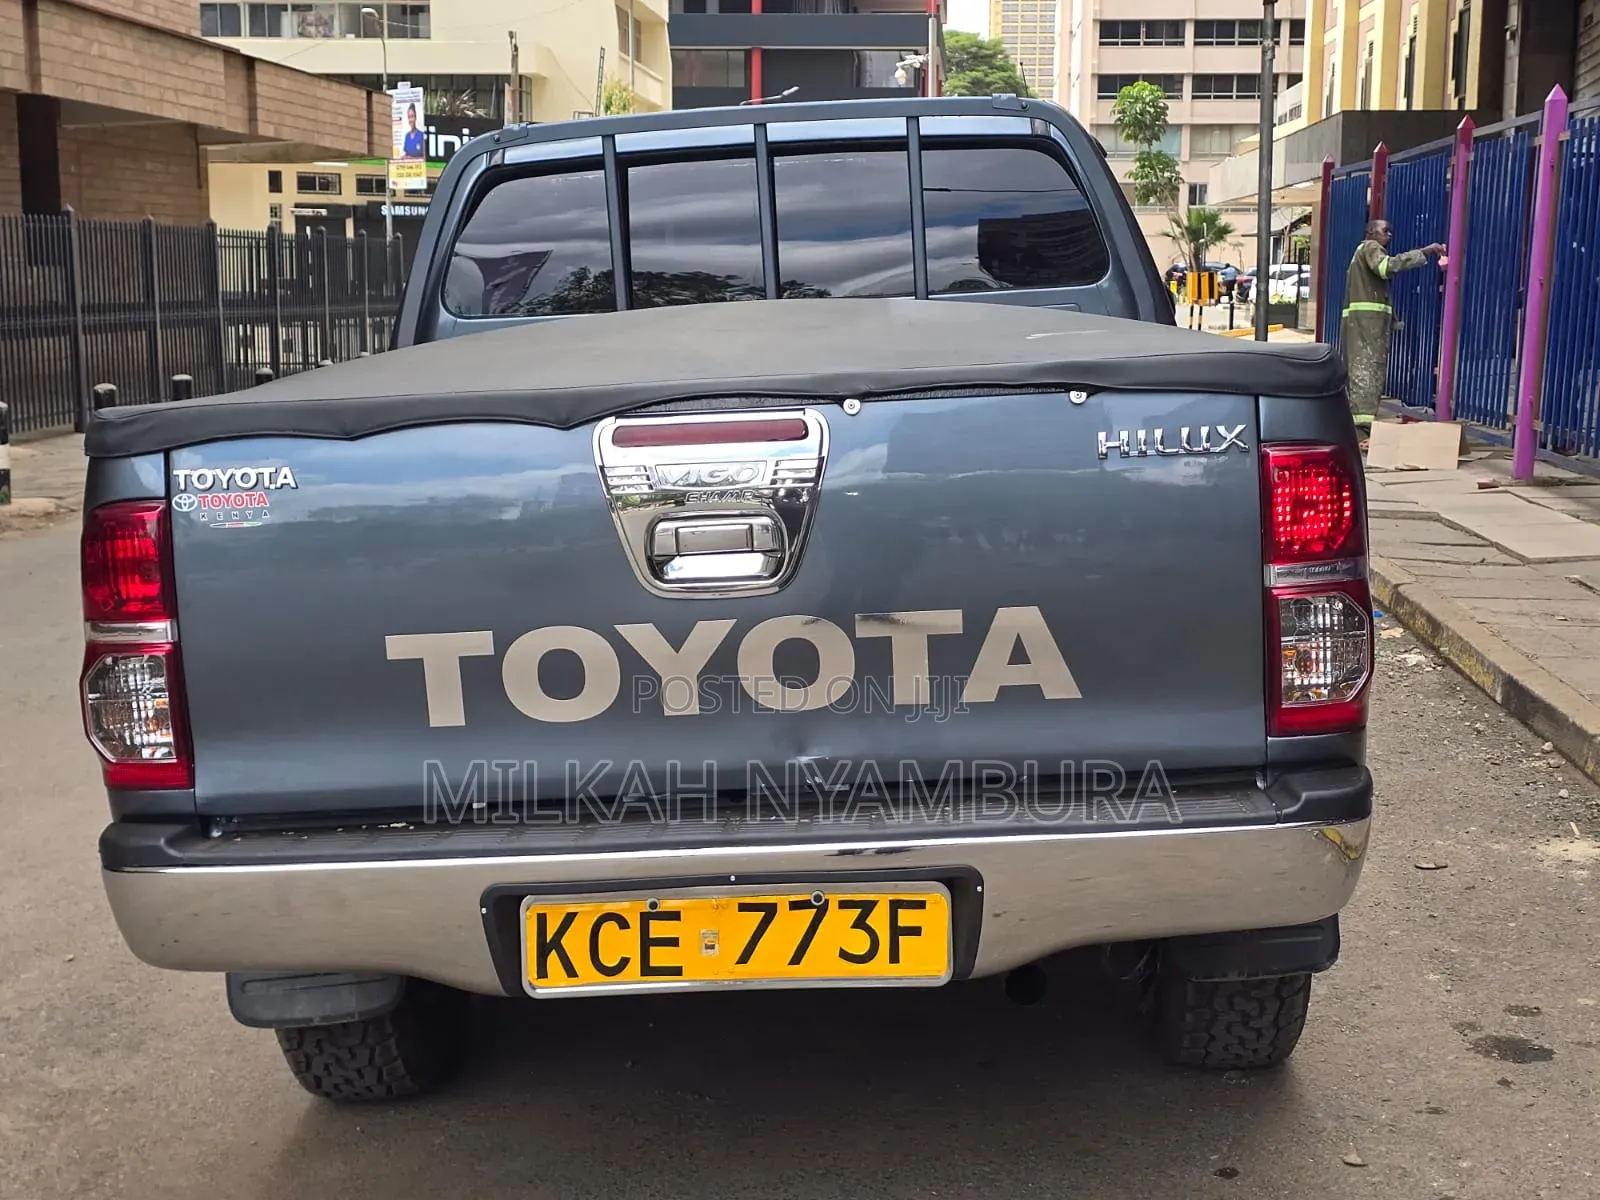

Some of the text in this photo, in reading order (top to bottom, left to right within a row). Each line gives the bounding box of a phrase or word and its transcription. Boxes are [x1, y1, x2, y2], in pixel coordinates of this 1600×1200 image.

[381, 205, 429, 216] SAMSUN
[1097, 424, 1249, 459] HILUX
[173, 466, 298, 491] TOYOTA
[659, 464, 760, 487] VIGO
[198, 491, 270, 510] TOYOTA
[200, 509, 271, 521] KENYA
[385, 605, 1083, 728] TOYOTA
[535, 911, 683, 979] KCE
[734, 899, 927, 966] 773F
